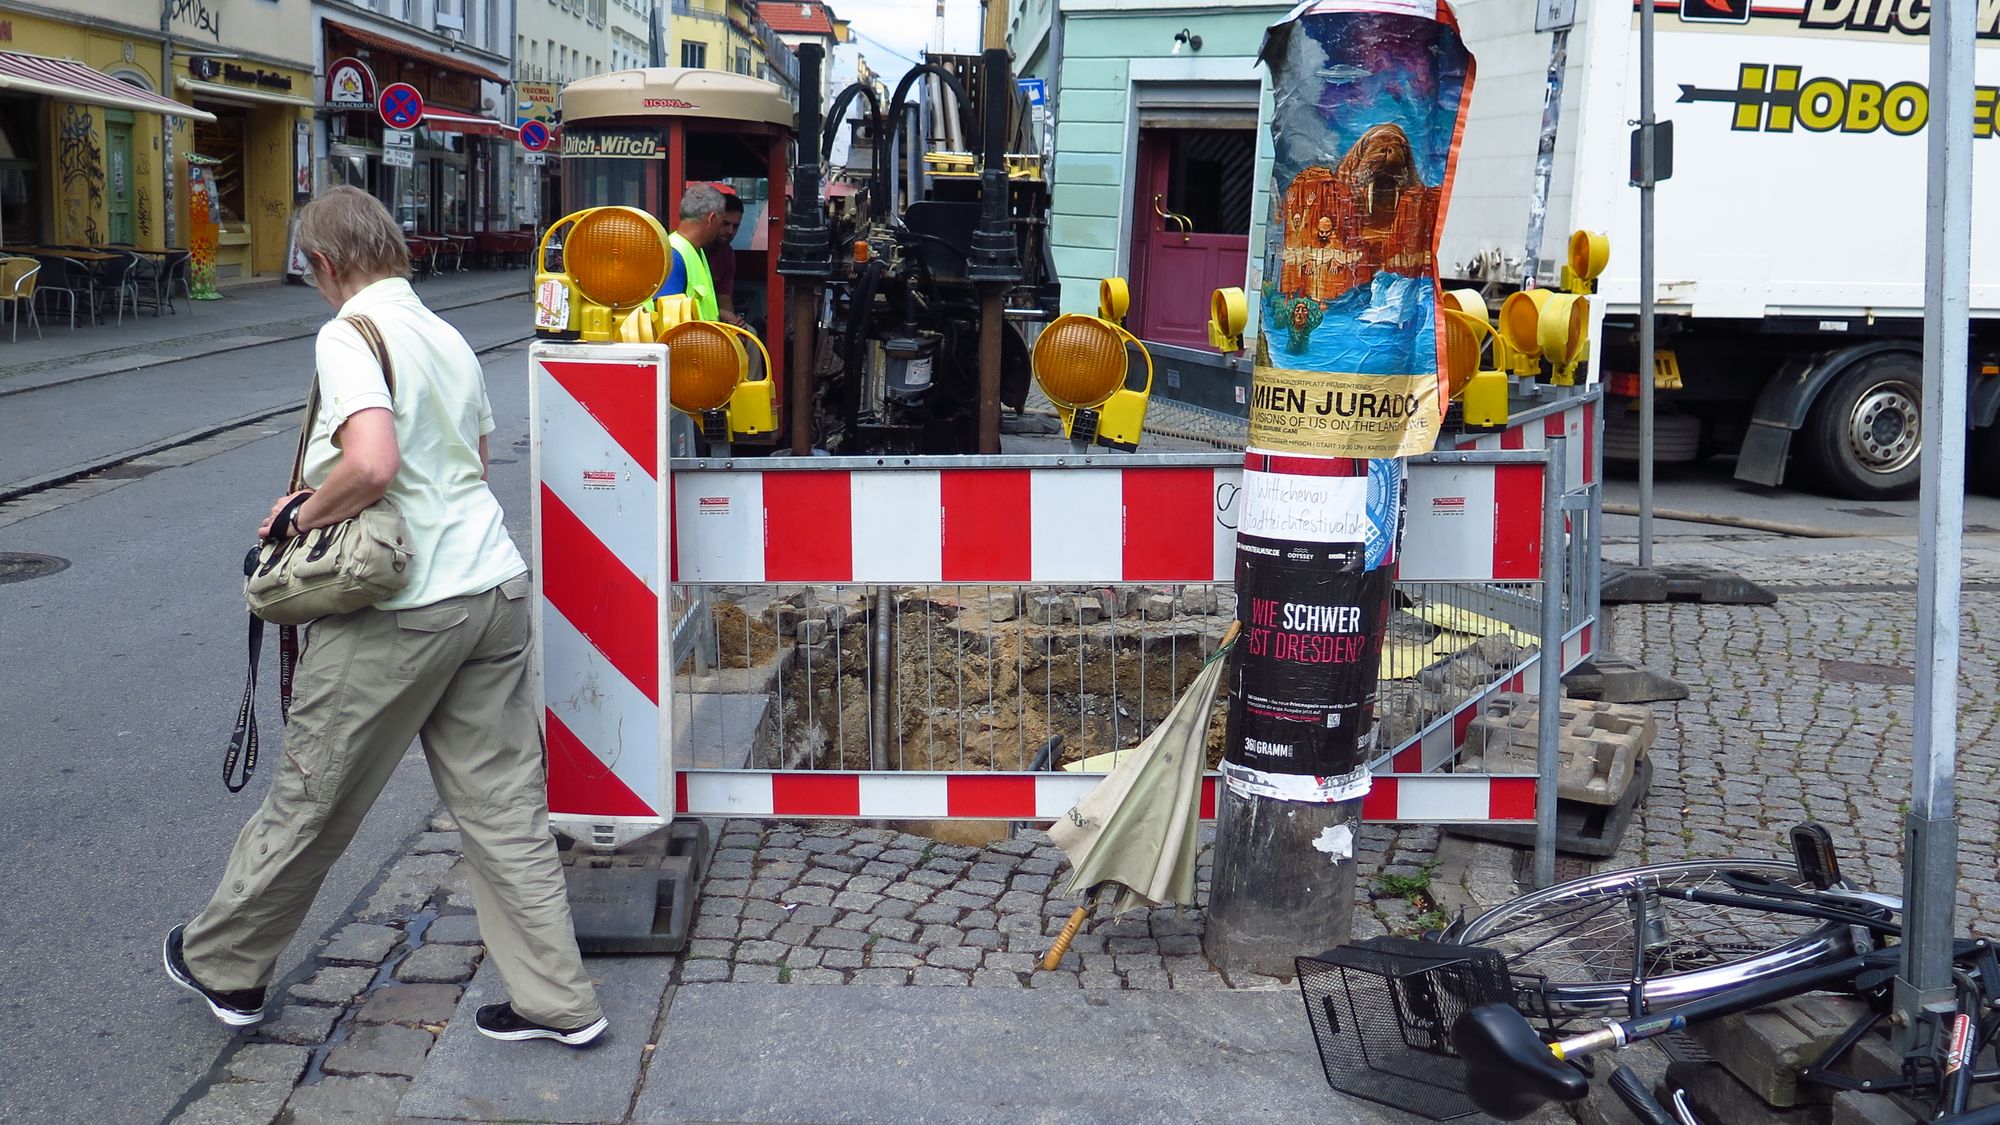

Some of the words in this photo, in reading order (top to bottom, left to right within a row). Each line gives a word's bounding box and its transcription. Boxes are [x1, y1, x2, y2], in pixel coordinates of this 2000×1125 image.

[522, 87, 550, 95] VECCHIA
[529, 95, 554, 103] NAPOLI
[1731, 63, 2000, 138] HOBOE
[565, 135, 595, 155] Ditch
[601, 135, 656, 155] Witch
[1316, 391, 1419, 418] JURADO
[1290, 415, 1303, 428] OF
[1309, 417, 1328, 430] US
[1330, 419, 1350, 431] ON
[1353, 420, 1375, 432] THE
[1316, 441, 1336, 449] START
[1287, 551, 1314, 560] ODYSSEY
[1252, 597, 1279, 628] WIE
[1282, 603, 1361, 633] SCHWER
[1250, 627, 1271, 656] IST
[1275, 632, 1366, 663] DRESDEN?
[282, 651, 290, 686] UNHEILIG
[1257, 741, 1288, 758] GRAMM
